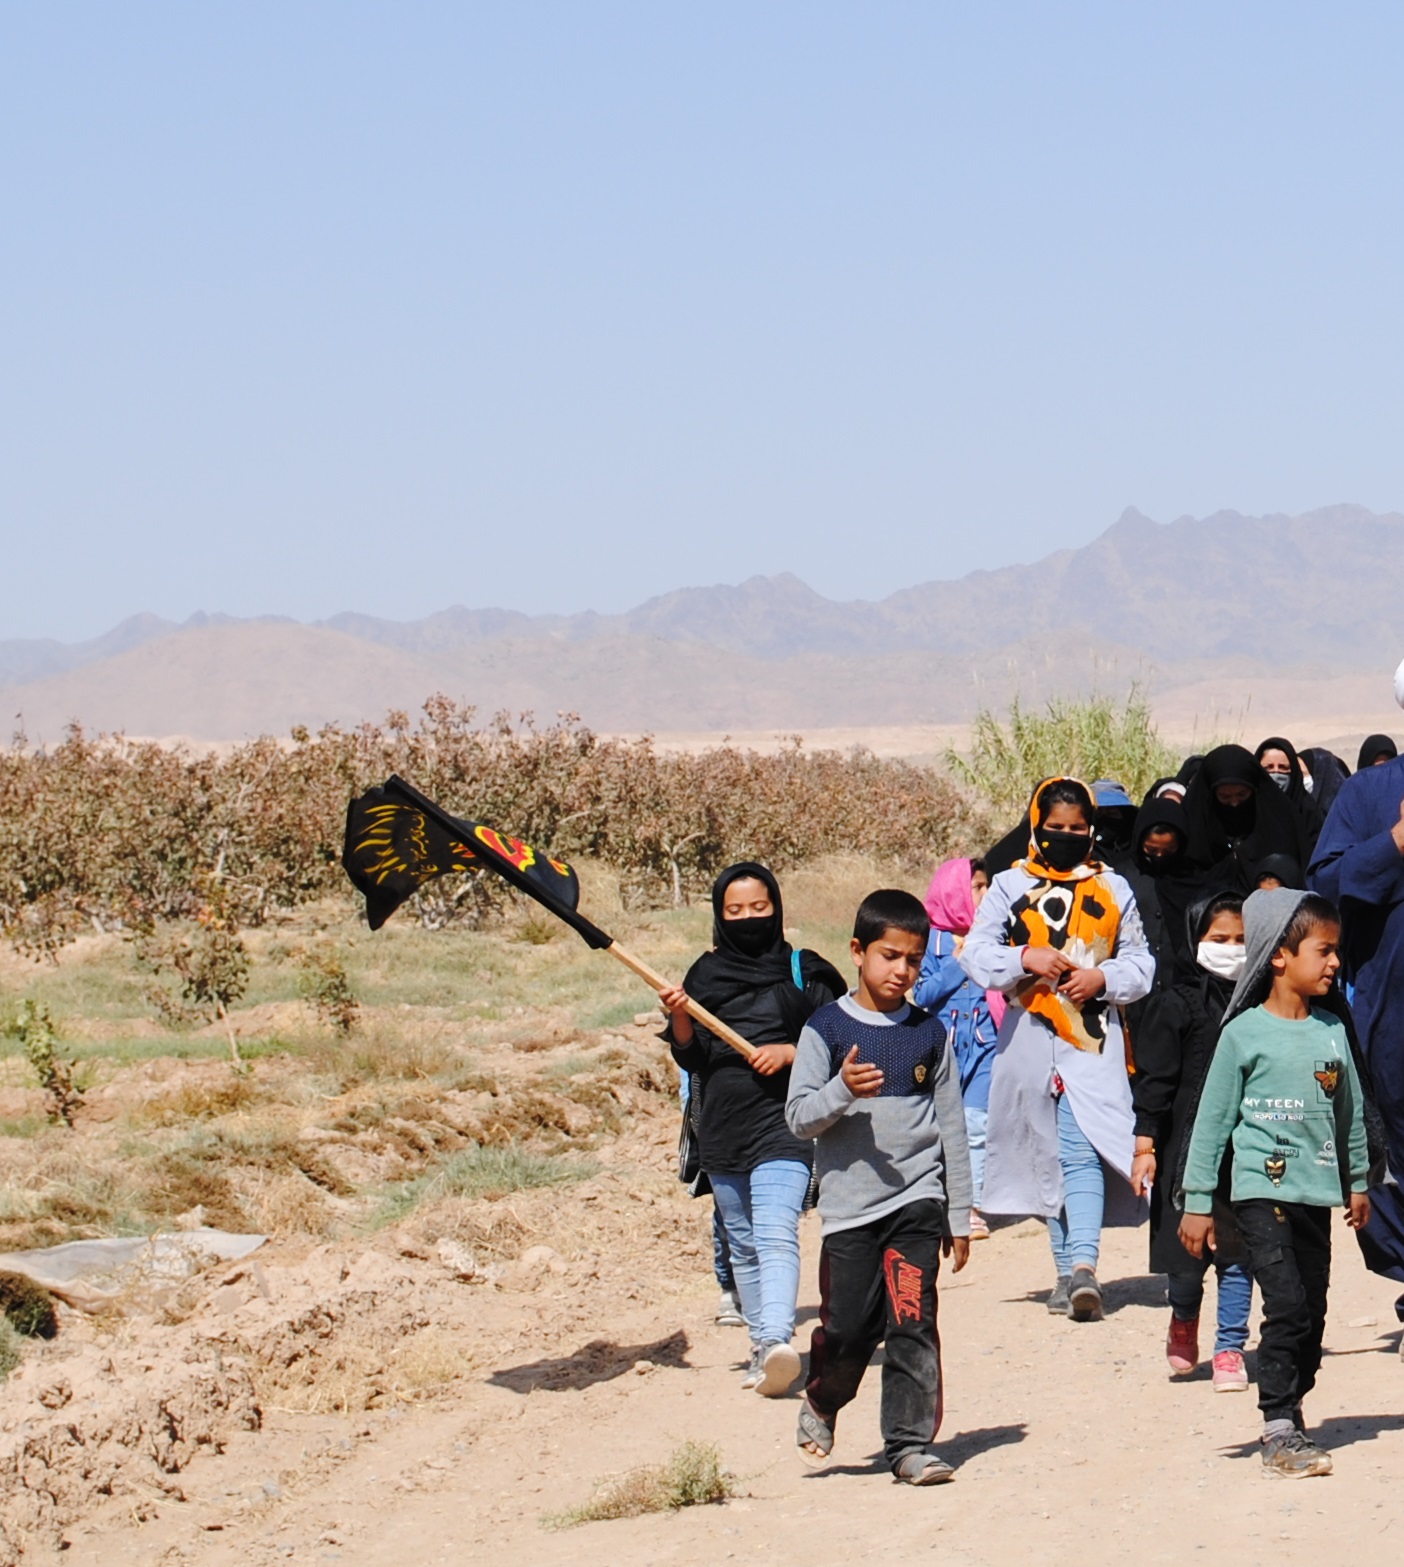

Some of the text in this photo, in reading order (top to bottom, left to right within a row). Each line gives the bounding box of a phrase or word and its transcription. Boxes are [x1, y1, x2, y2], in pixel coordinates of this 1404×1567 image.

[1244, 1097, 1304, 1108] MY TEEN
[898, 1261, 923, 1321] NIKE
